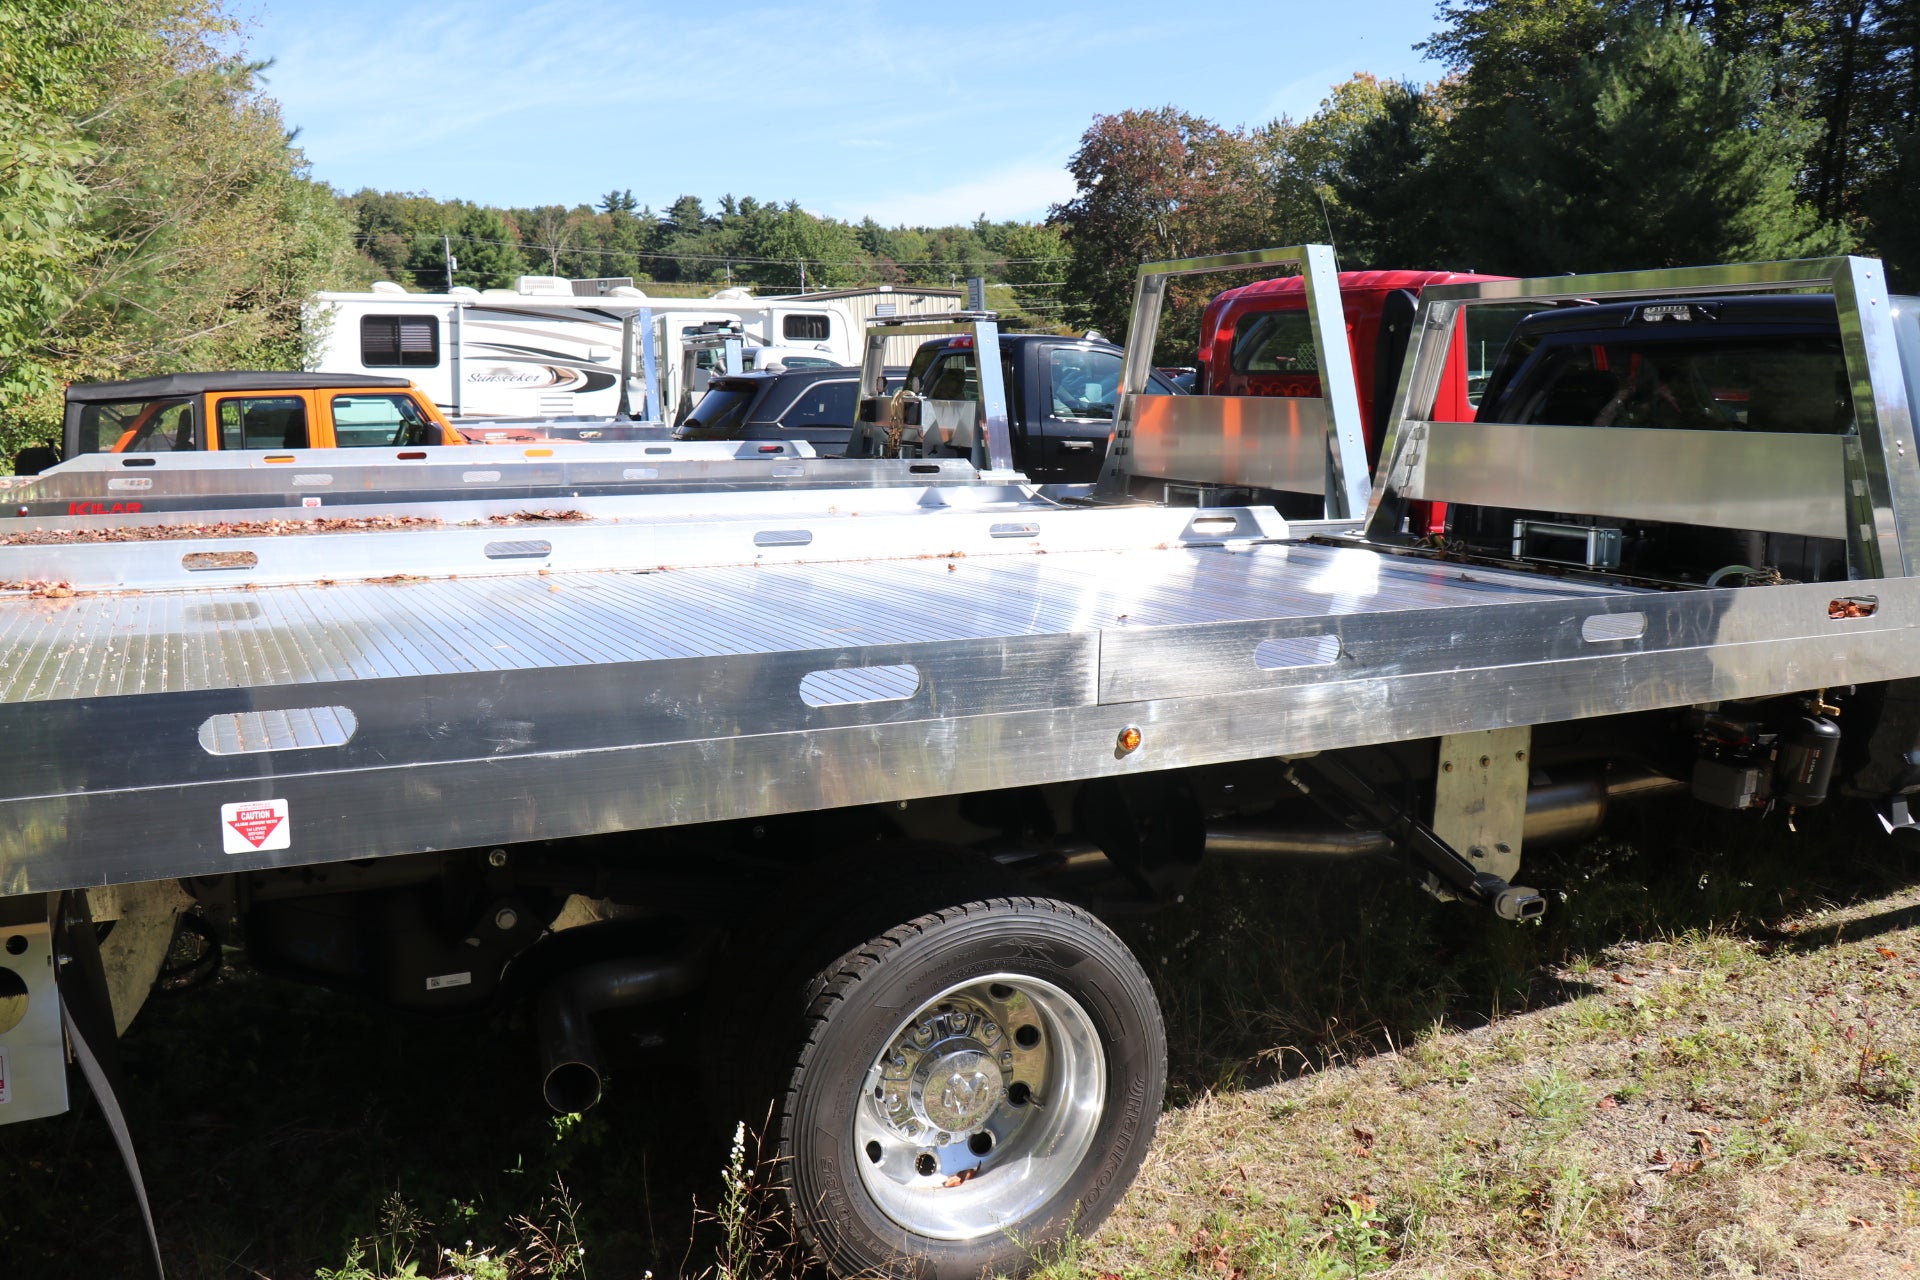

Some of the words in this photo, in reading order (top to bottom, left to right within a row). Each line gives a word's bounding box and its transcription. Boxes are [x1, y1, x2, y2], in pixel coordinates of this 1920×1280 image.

[467, 372, 541, 383] Sunseeker
[68, 501, 142, 516] KILAR
[241, 810, 271, 820] CAUTION
